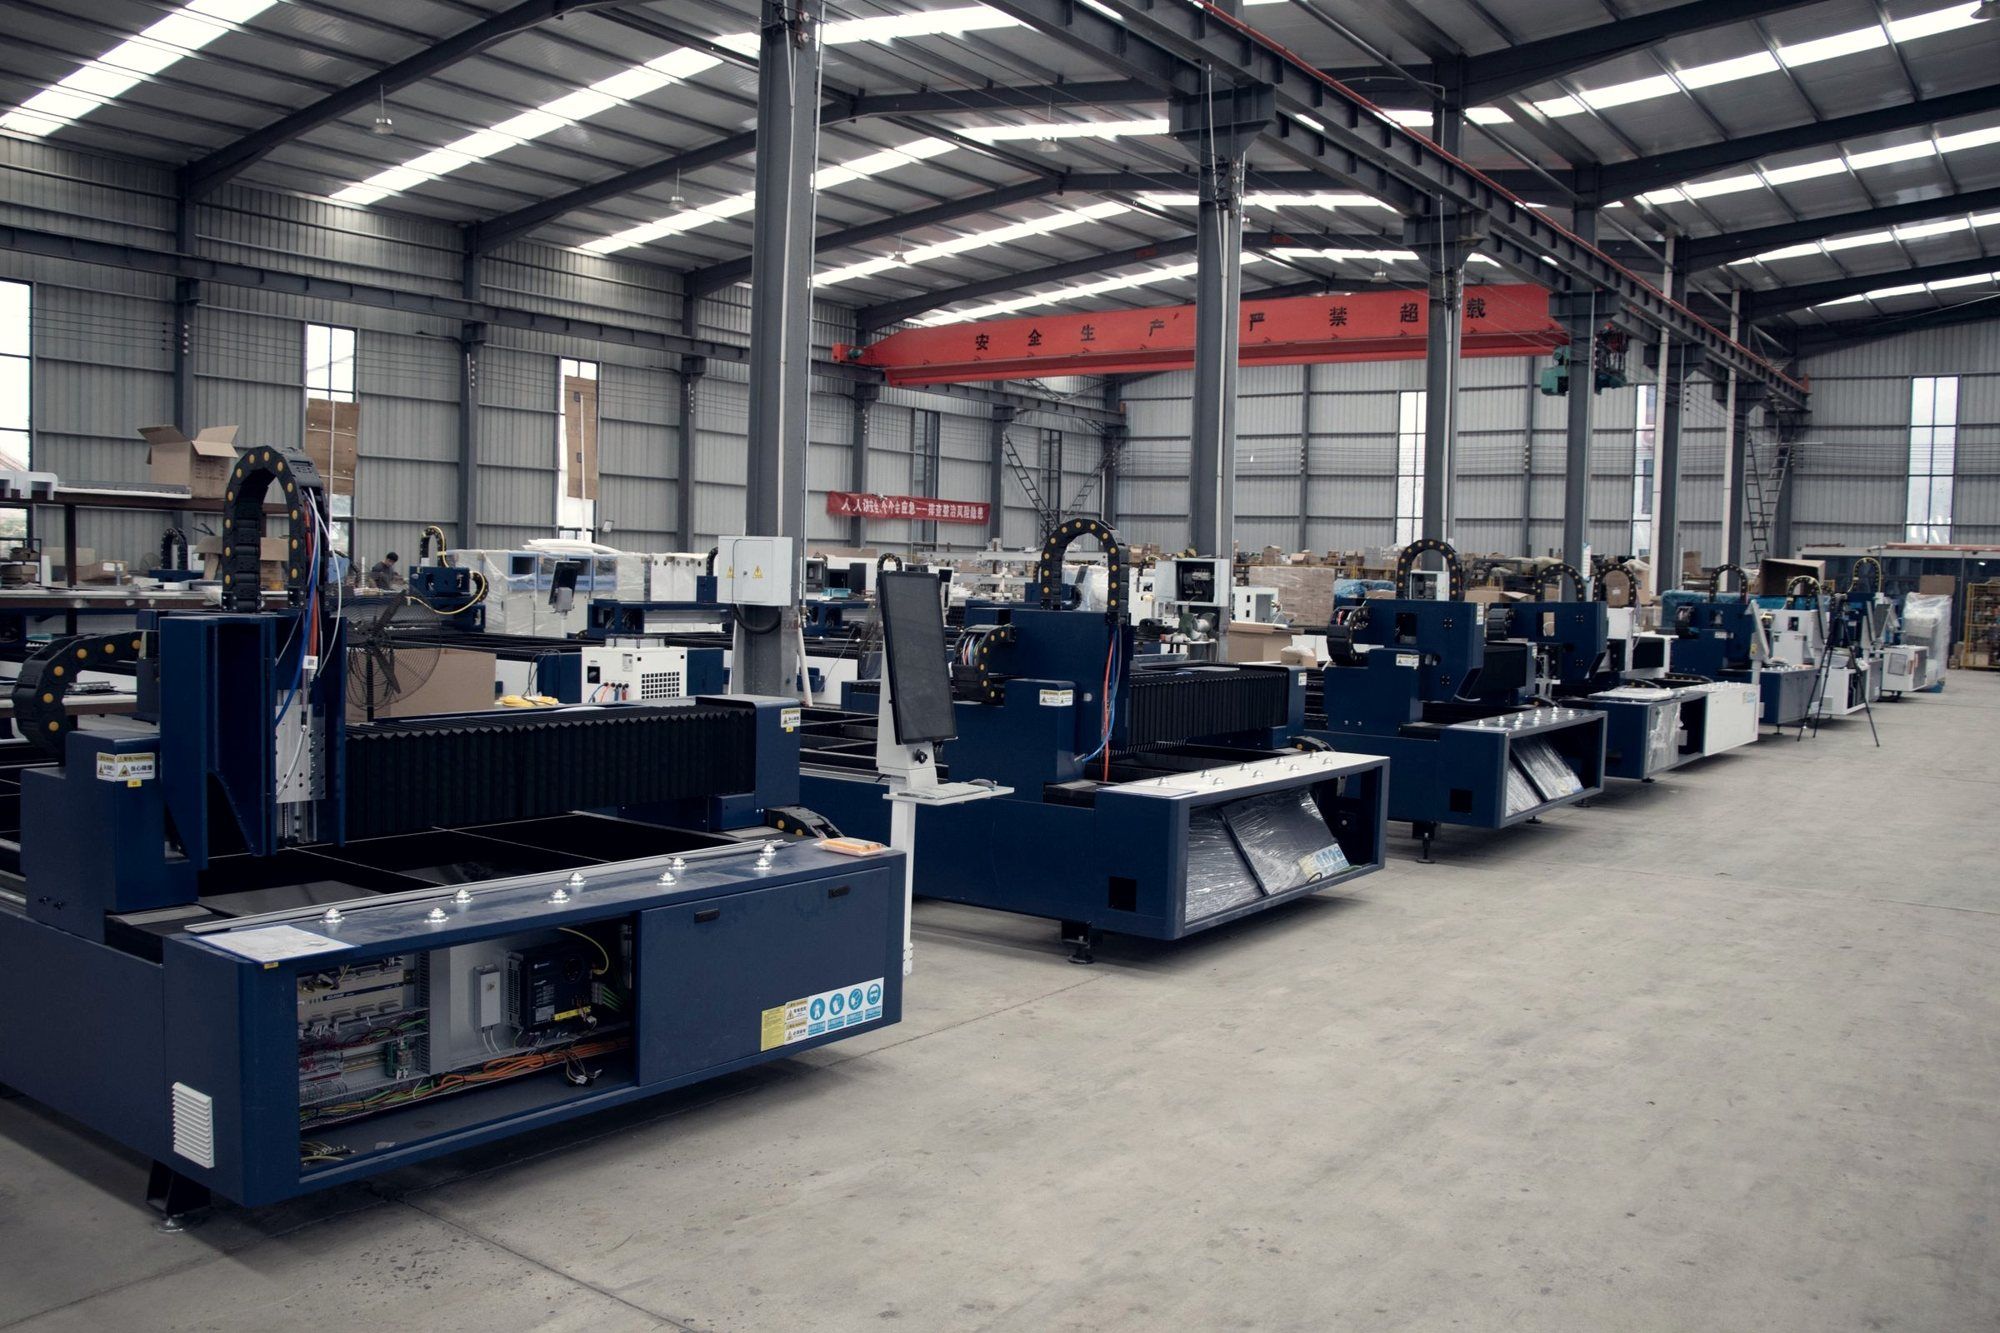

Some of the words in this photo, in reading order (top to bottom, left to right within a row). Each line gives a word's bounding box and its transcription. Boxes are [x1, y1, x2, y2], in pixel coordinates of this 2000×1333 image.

[976, 319, 1165, 350] 安全生产
[1249, 298, 1486, 331] 严禁超载
